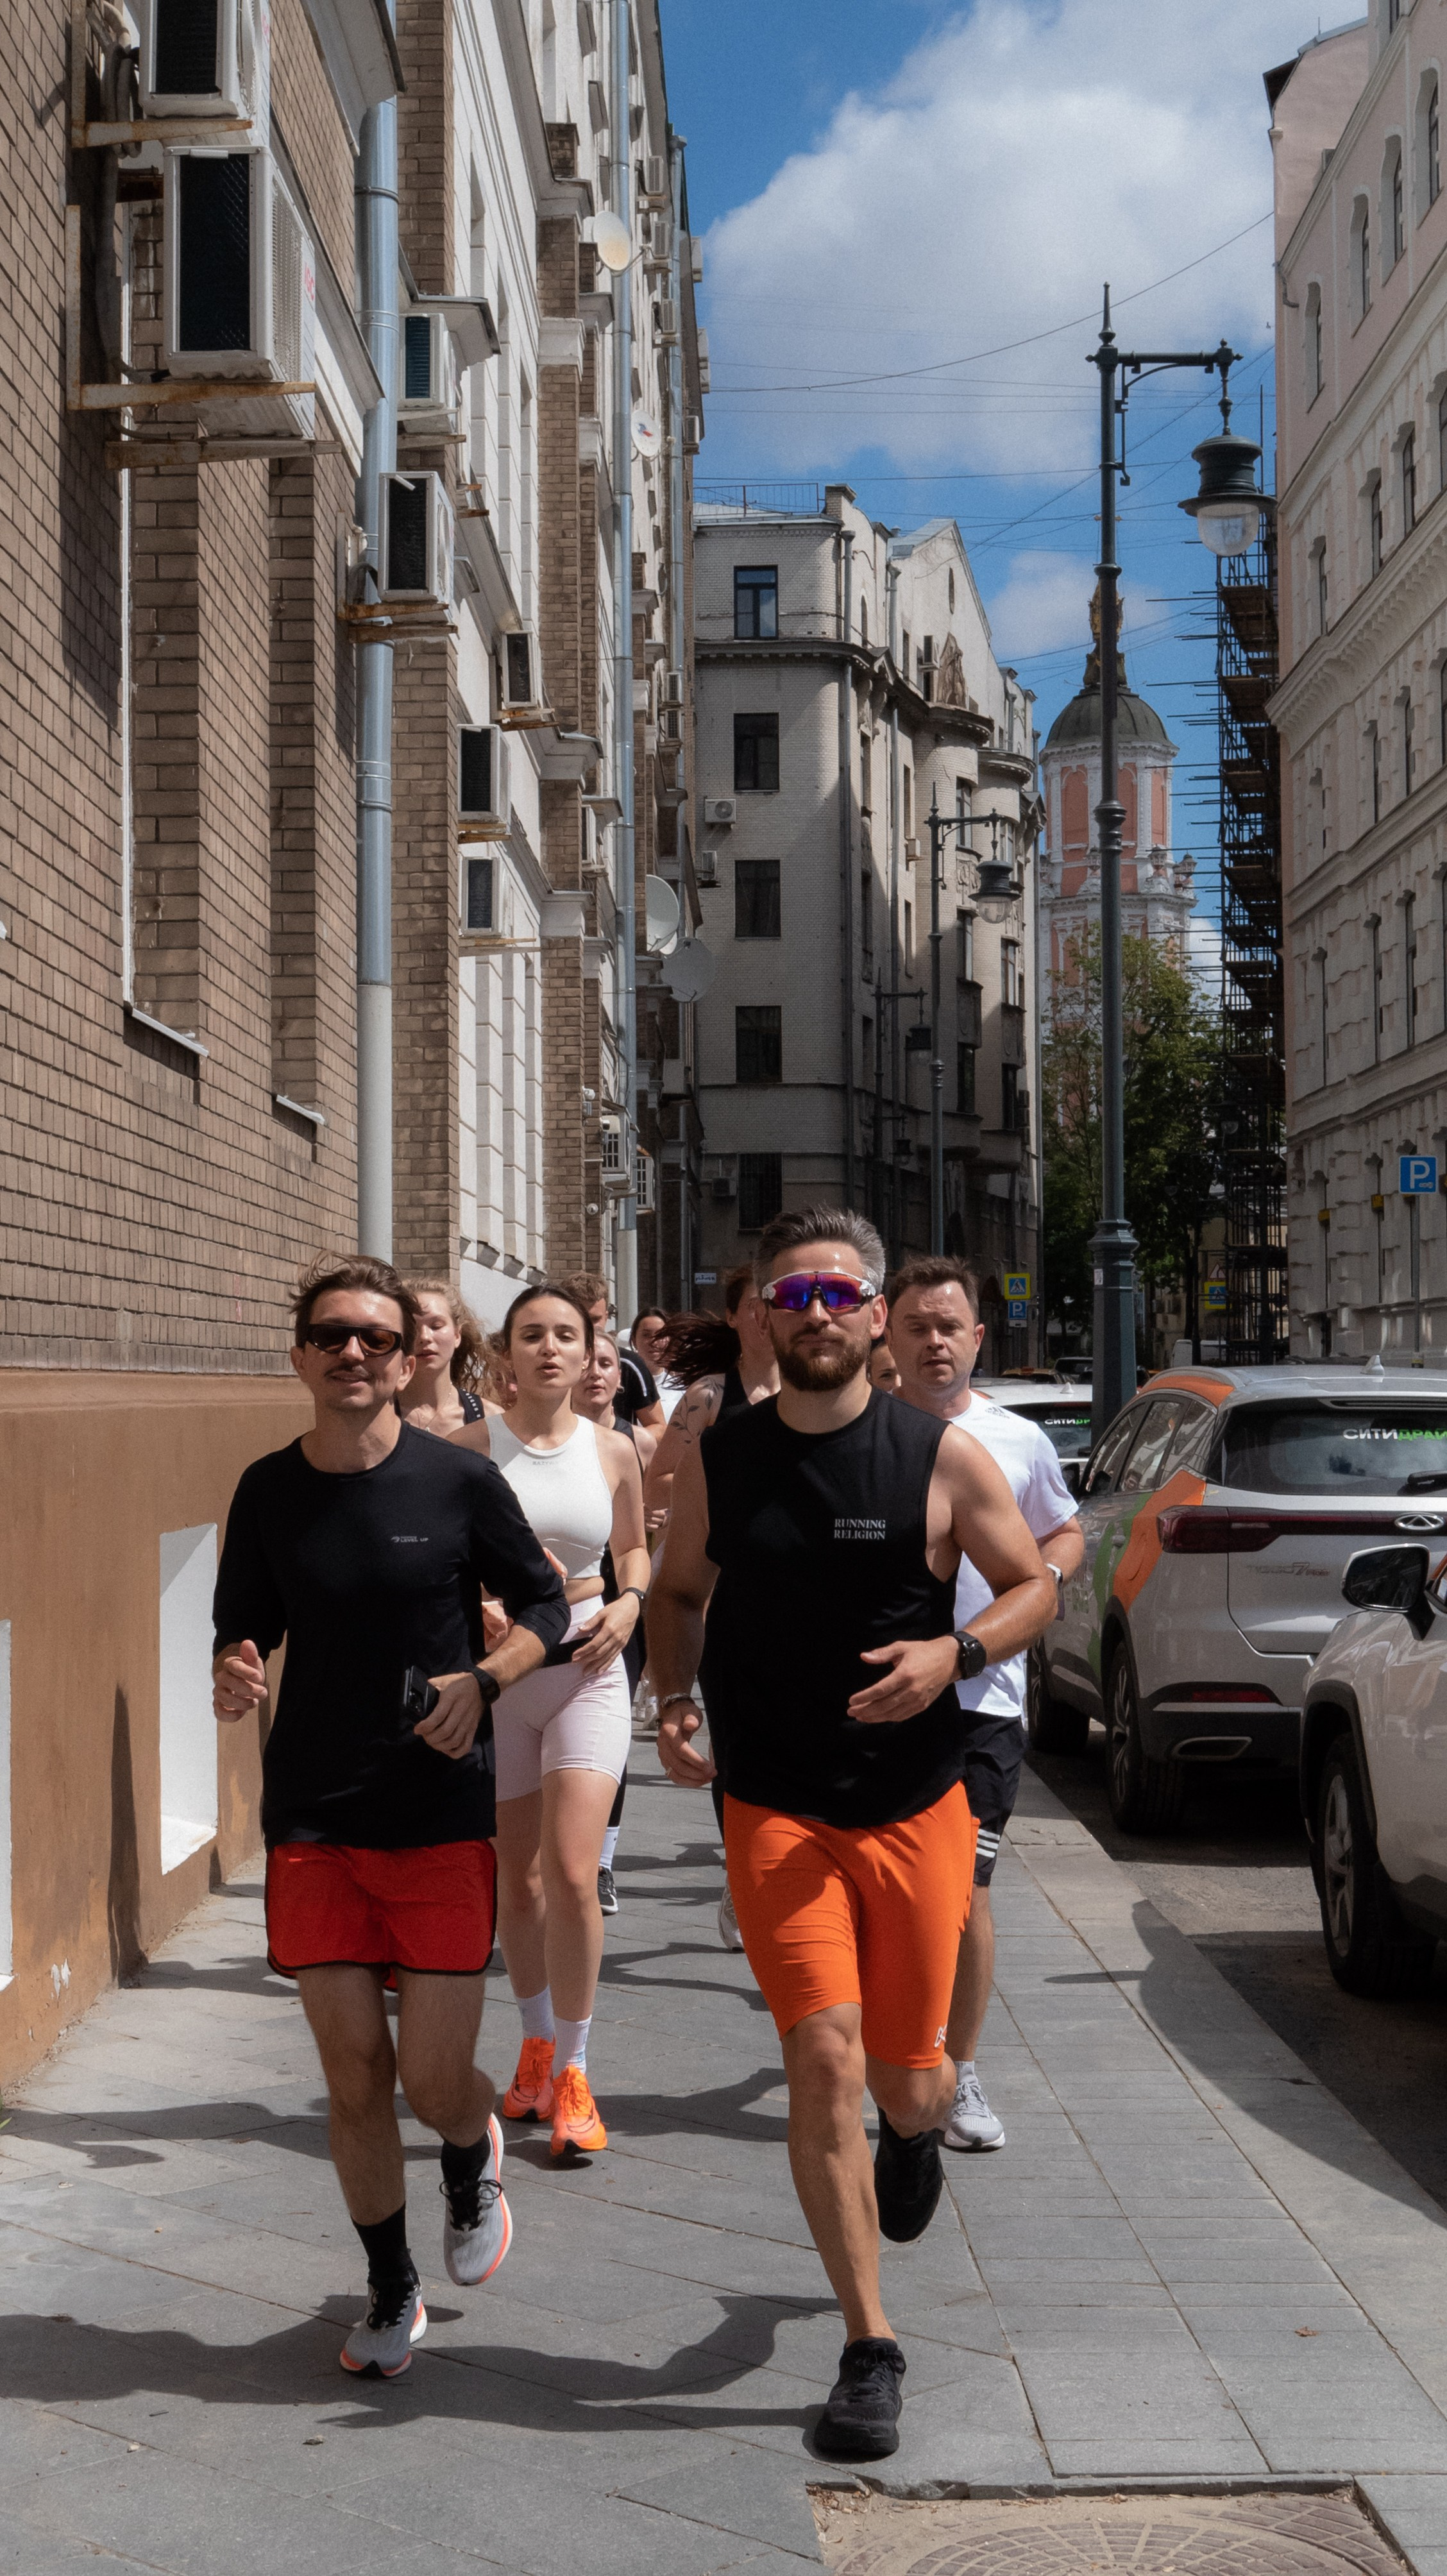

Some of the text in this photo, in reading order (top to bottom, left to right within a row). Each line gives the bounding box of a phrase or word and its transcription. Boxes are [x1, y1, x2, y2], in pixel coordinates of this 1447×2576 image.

[1410, 1160, 1430, 1189] P
[1012, 1302, 1023, 1317] P
[834, 1518, 886, 1529] RUNNING
[834, 1529, 886, 1540] RELIGION
[1293, 1562, 1310, 1576] 7
